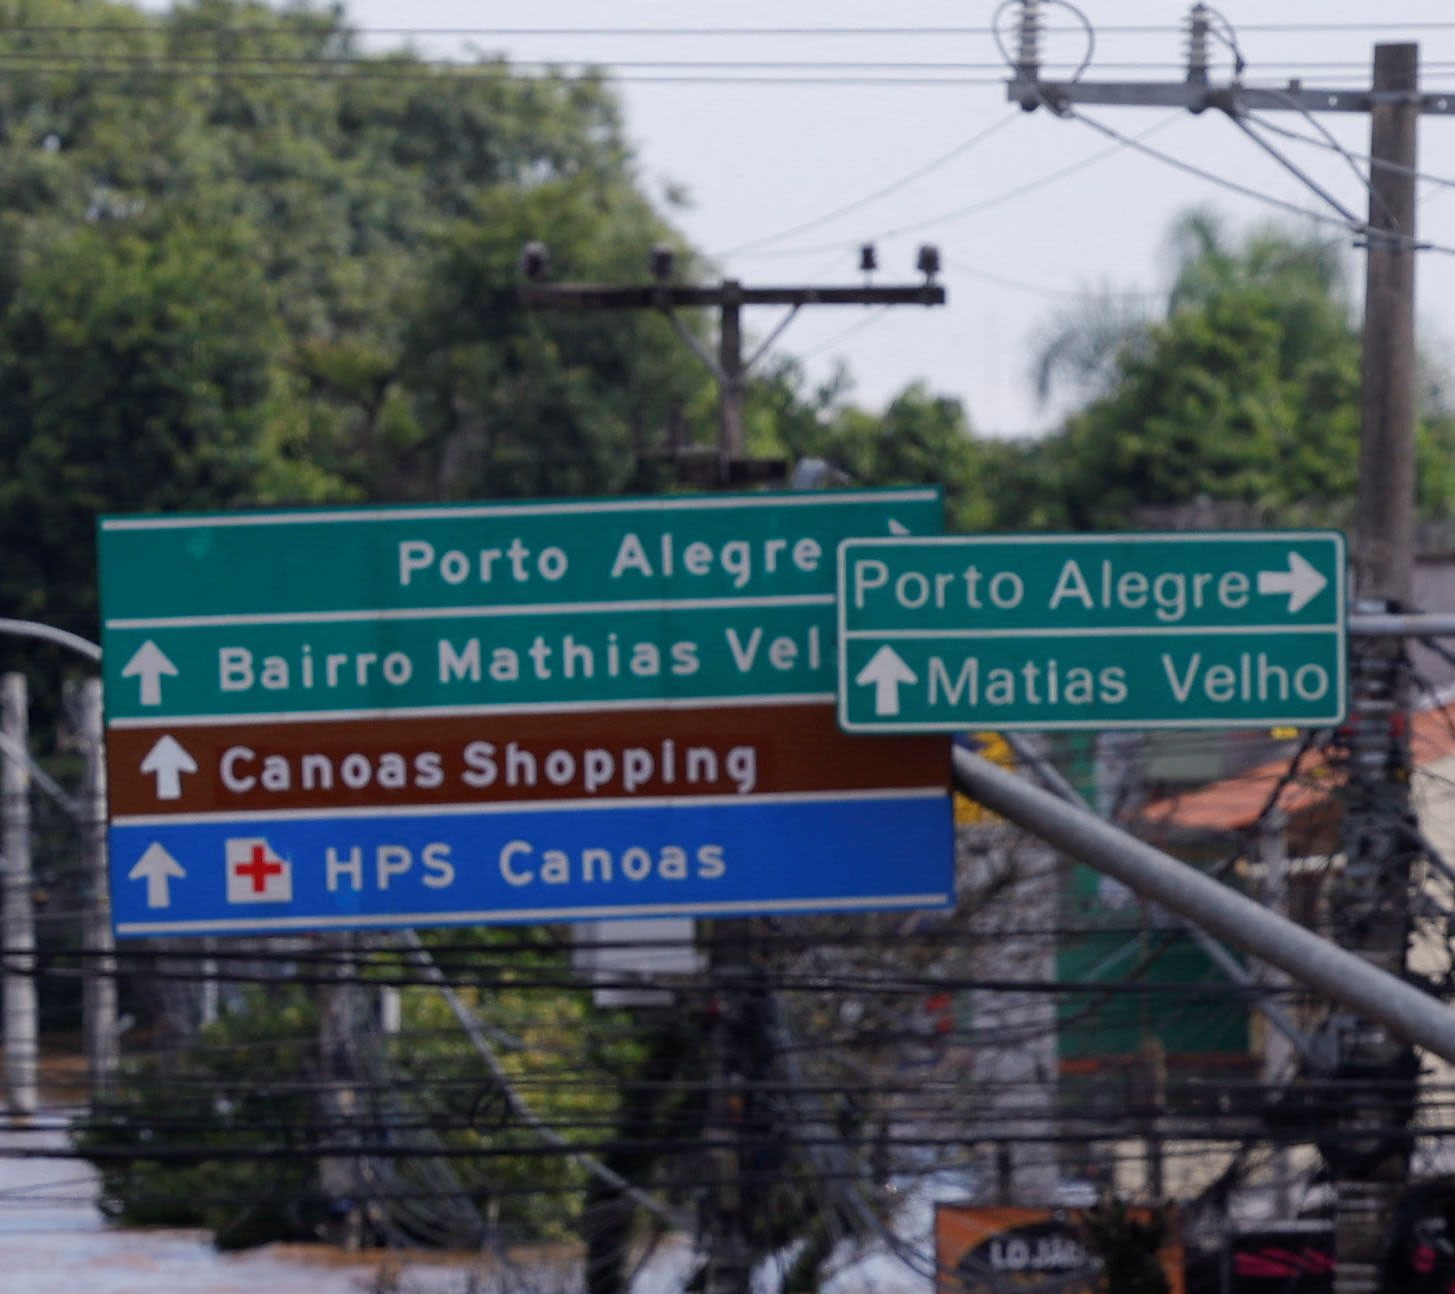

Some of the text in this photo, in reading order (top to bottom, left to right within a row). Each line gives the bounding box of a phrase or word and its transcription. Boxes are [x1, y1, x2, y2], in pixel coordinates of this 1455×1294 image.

[397, 532, 823, 592] Porto Alegre
[852, 558, 1252, 620] Porto Alegre
[218, 644, 413, 692] Bairro
[437, 633, 701, 683] Mathias
[928, 652, 1330, 707] Matias Velho
[220, 738, 760, 794] Canoas Shopping
[324, 838, 726, 891] HPS Canoas
